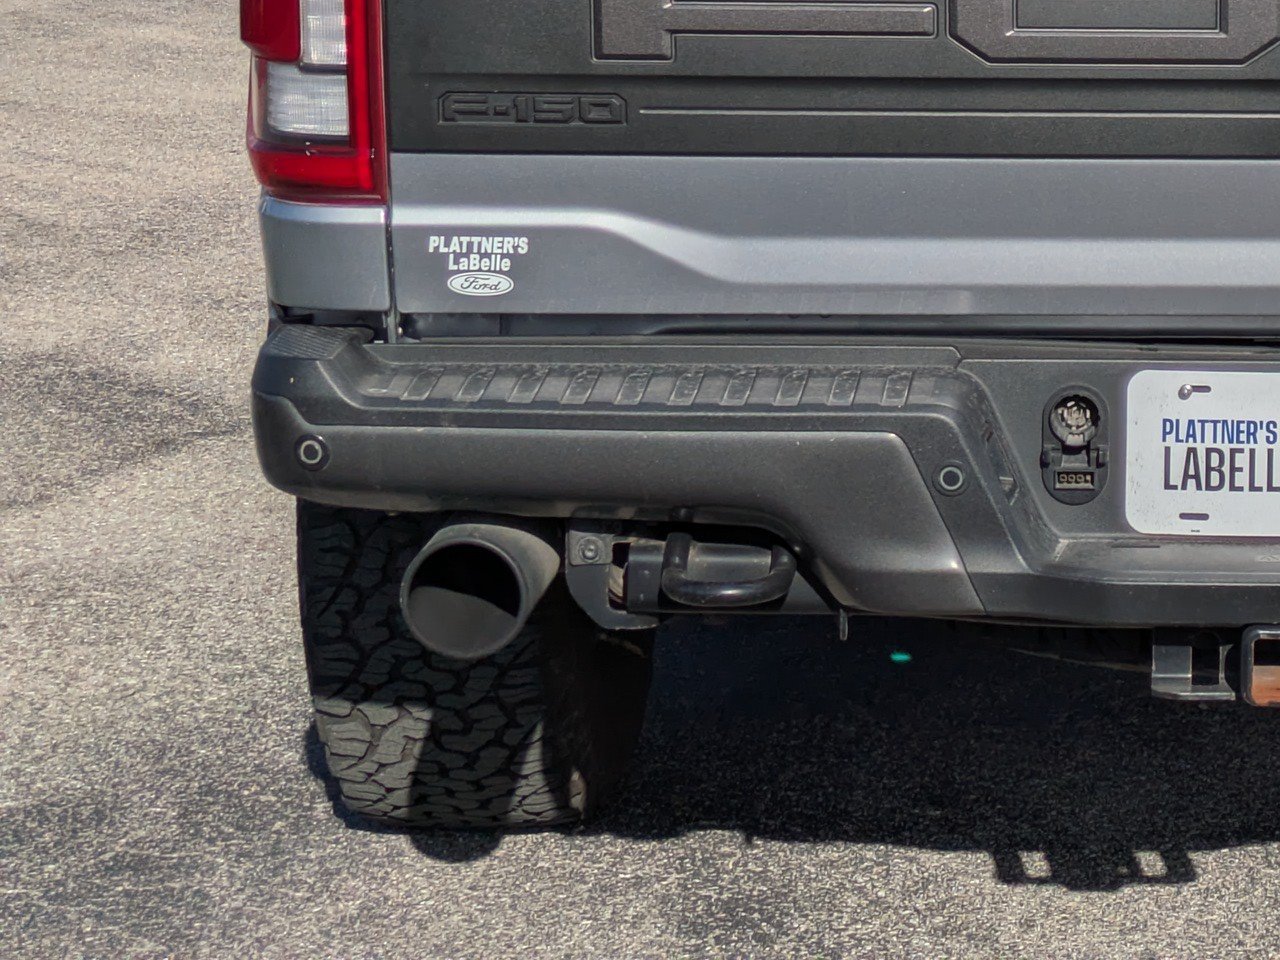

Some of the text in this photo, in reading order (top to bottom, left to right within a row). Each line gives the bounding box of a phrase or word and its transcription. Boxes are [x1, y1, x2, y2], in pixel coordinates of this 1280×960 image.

[442, 93, 627, 124] F-150
[428, 236, 529, 254] PLATTNER'S
[448, 253, 511, 271] LaBelle
[460, 276, 503, 291] Ford
[1161, 418, 1278, 445] PLATTNER'S
